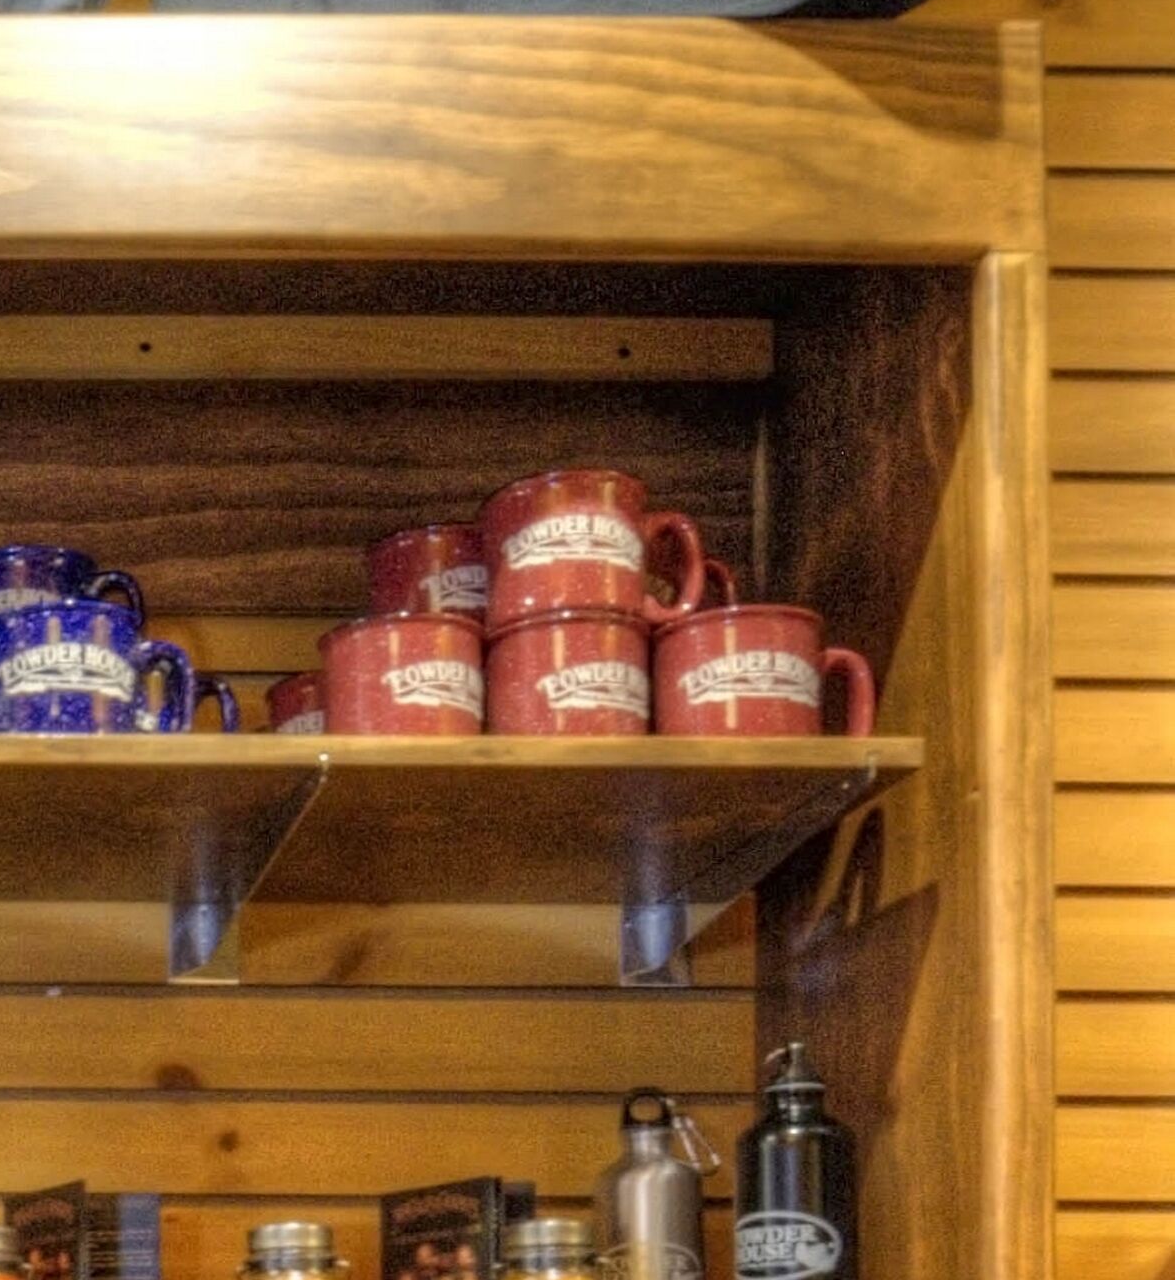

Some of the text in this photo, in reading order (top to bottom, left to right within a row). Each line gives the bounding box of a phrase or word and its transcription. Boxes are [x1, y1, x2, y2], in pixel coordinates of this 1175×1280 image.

[418, 565, 488, 602] POWD
[678, 650, 772, 699] POWDER
[737, 1223, 816, 1245] OWDER
[737, 1242, 794, 1264] OUSE
